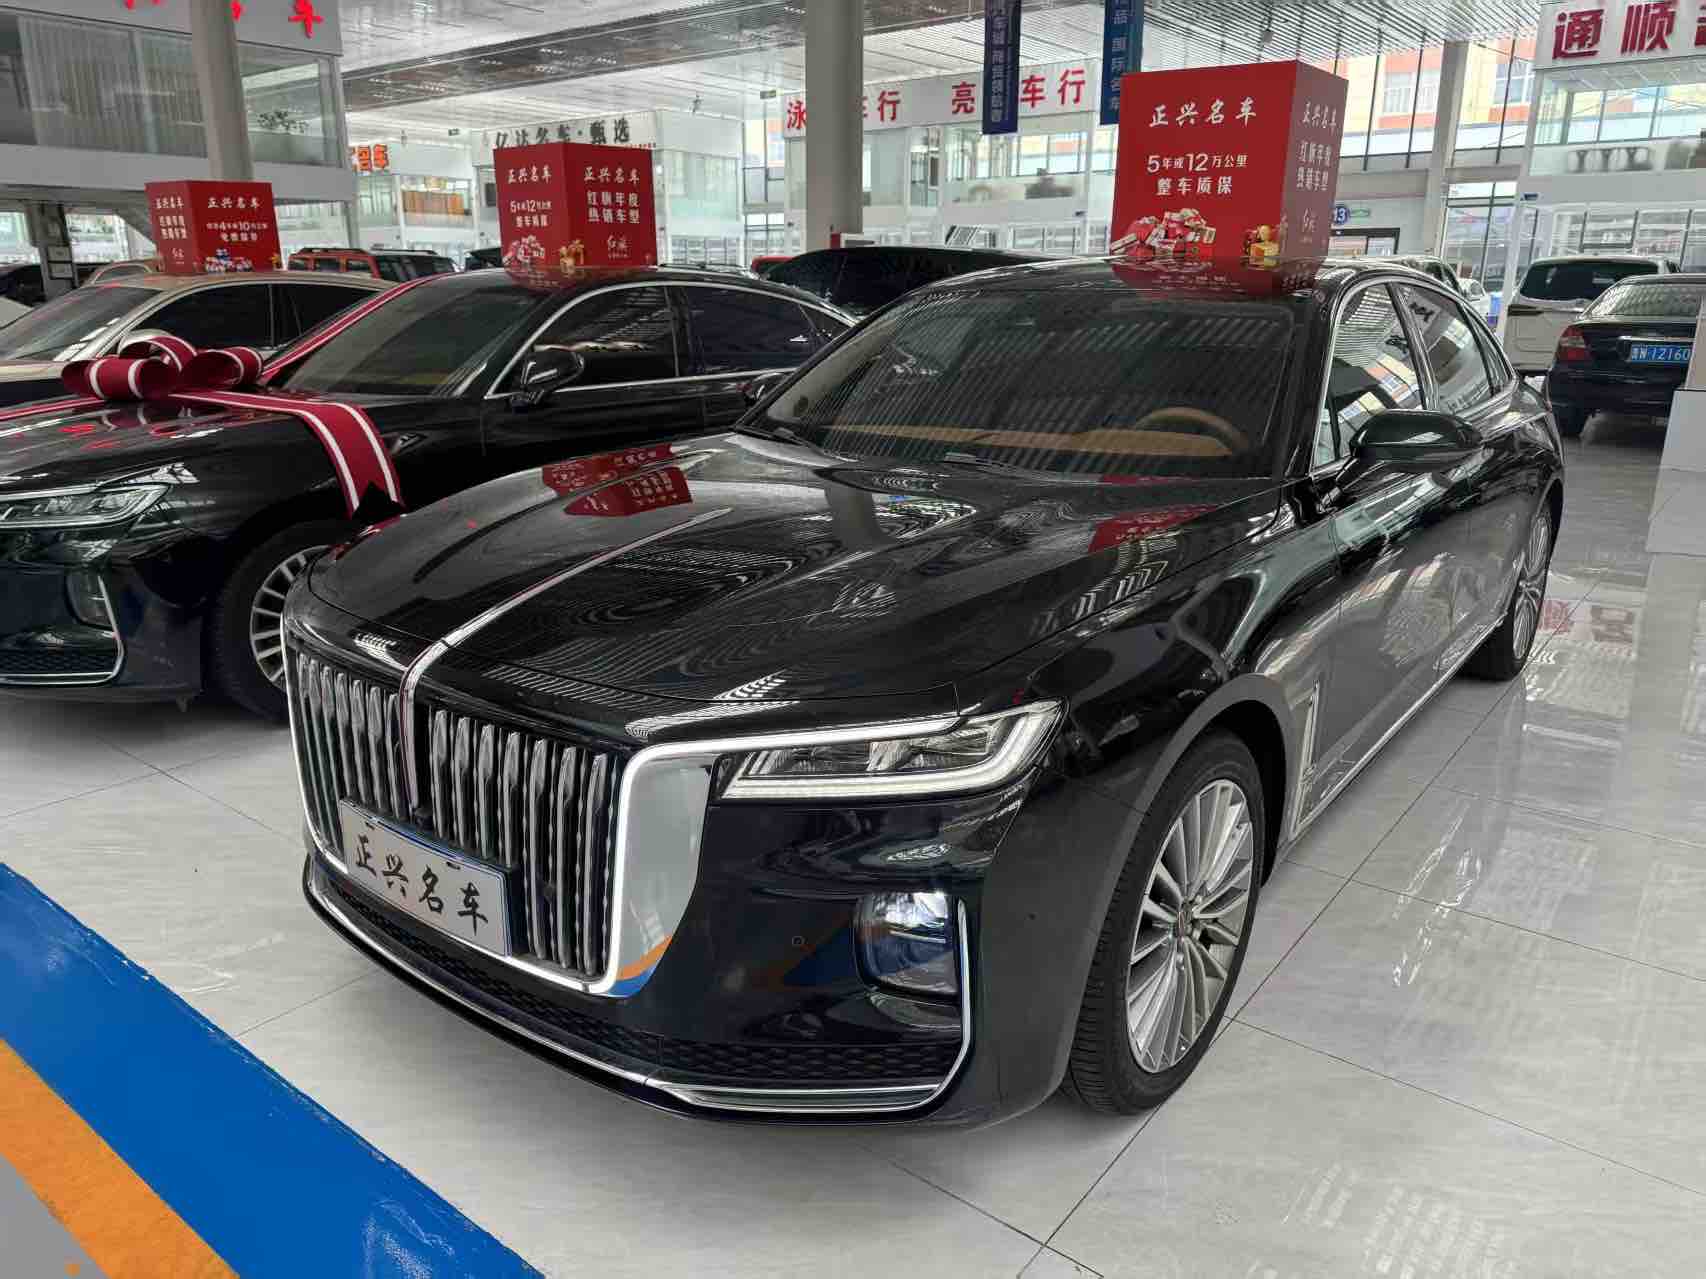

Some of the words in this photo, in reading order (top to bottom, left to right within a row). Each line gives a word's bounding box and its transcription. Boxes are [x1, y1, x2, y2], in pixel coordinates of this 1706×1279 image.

[951, 69, 1086, 115] 亮车行
[1149, 97, 1257, 128] 正兴名车
[1147, 152, 1249, 173] 5年或12万公里
[507, 164, 552, 184] 正兴名车
[584, 166, 640, 185] 正兴名车
[1156, 176, 1233, 196] 整车质保
[356, 834, 489, 937] 正兴名车
